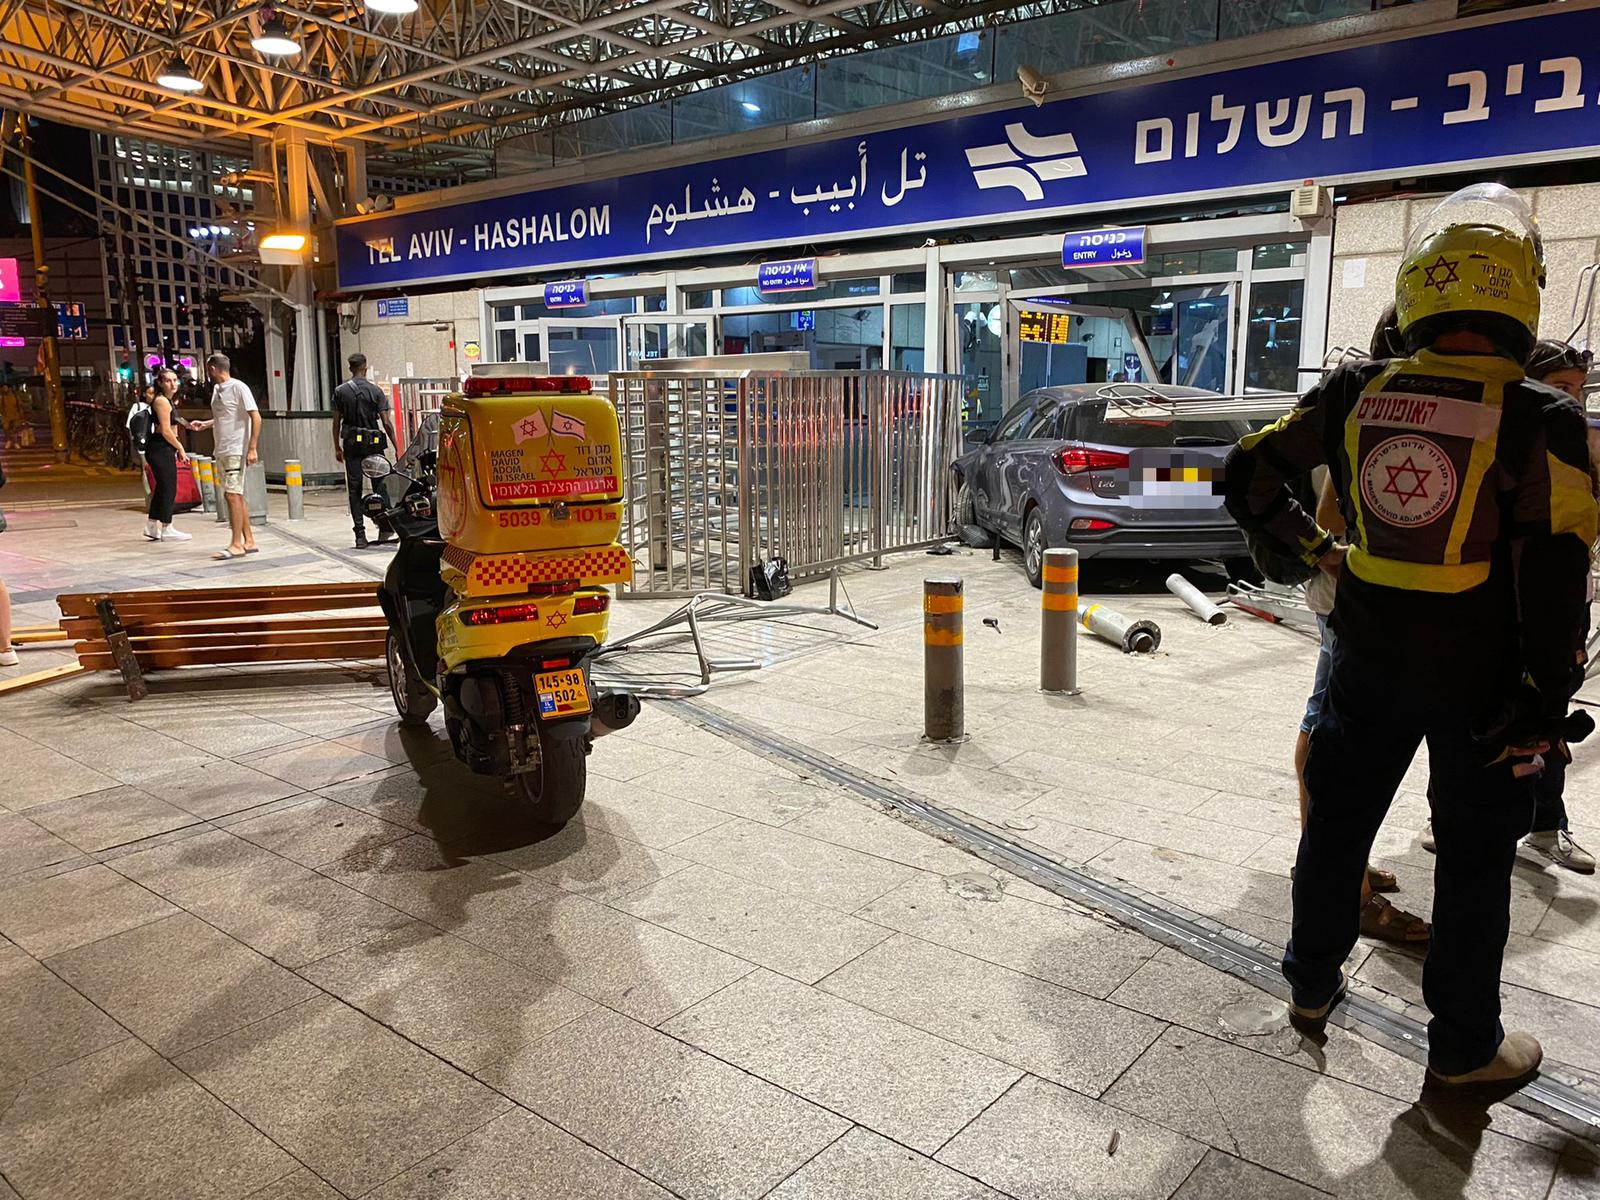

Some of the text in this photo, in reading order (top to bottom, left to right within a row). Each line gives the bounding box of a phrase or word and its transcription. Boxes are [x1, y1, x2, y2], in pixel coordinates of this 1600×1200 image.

[1134, 55, 1600, 165] ביב - השלום
[646, 140, 927, 245] تل أبيب - هشلوم
[365, 205, 610, 265] TEL AVIV - HASHALOM
[1080, 232, 1126, 247] כניסה
[1073, 250, 1097, 260] ENTRY
[1110, 248, 1133, 259] دخول
[765, 263, 808, 276] אין כניסה
[552, 284, 576, 294] כניסה
[1490, 276, 1512, 289] אדום
[1473, 284, 1509, 300] בישראל
[378, 303, 386, 315] 10
[1356, 396, 1439, 425] האופנועים
[575, 444, 611, 455] מגן דוד
[1401, 441, 1426, 451] אדום
[490, 449, 524, 458] MAGEN
[1368, 443, 1398, 469] בישראל
[1427, 447, 1441, 463] דוד
[491, 458, 520, 467] DAVID
[587, 455, 612, 466] אדום
[492, 466, 521, 474] ADOM
[573, 466, 613, 477] בישראל
[493, 472, 536, 482] IN ISRAEL
[494, 479, 614, 496] ארגון ההצלה הלאומי
[1367, 479, 1449, 522] MAGEN DAVID ADOM IN ISRAEL
[499, 511, 541, 528] 5039
[573, 507, 603, 523] 101
[539, 673, 580, 689] 145-98
[555, 689, 577, 703] 502
